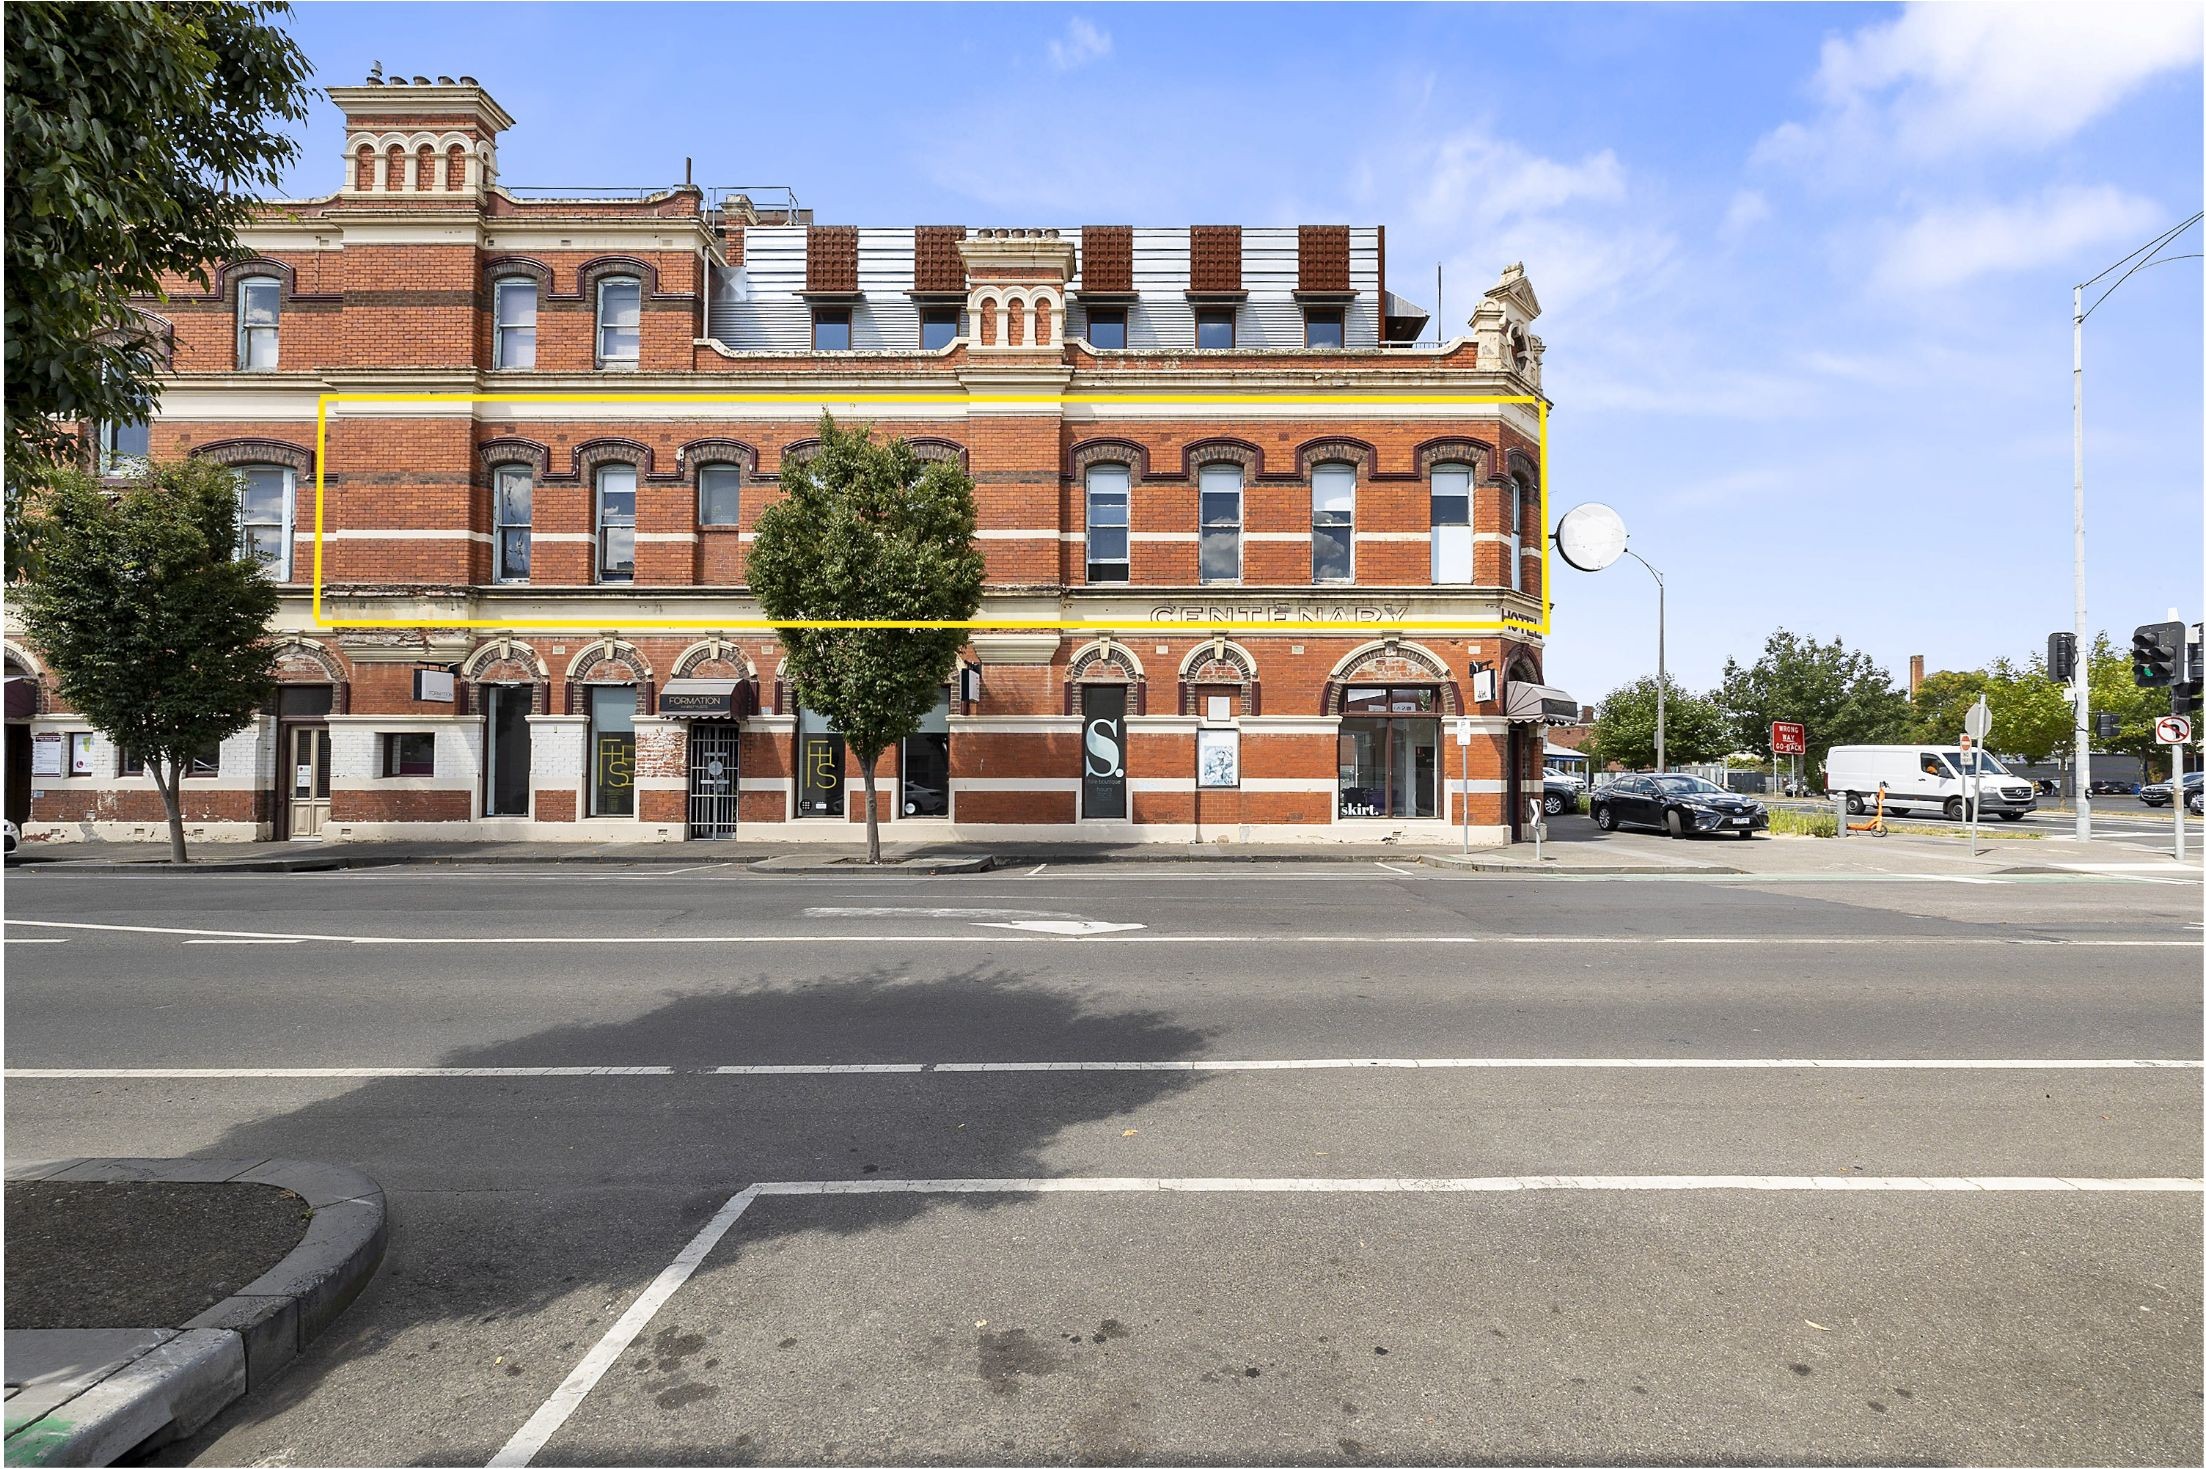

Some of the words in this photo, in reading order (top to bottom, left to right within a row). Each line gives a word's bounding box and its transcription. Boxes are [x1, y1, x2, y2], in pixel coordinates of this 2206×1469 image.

[1501, 607, 1542, 640] HOTEL
[668, 697, 720, 705] FORMATION
[1779, 725, 1798, 733] WRONG
[1782, 733, 1795, 741] WAY
[1775, 742, 1784, 750] GO
[1786, 743, 1802, 752] BACK
[1341, 802, 1379, 816] skirt.
